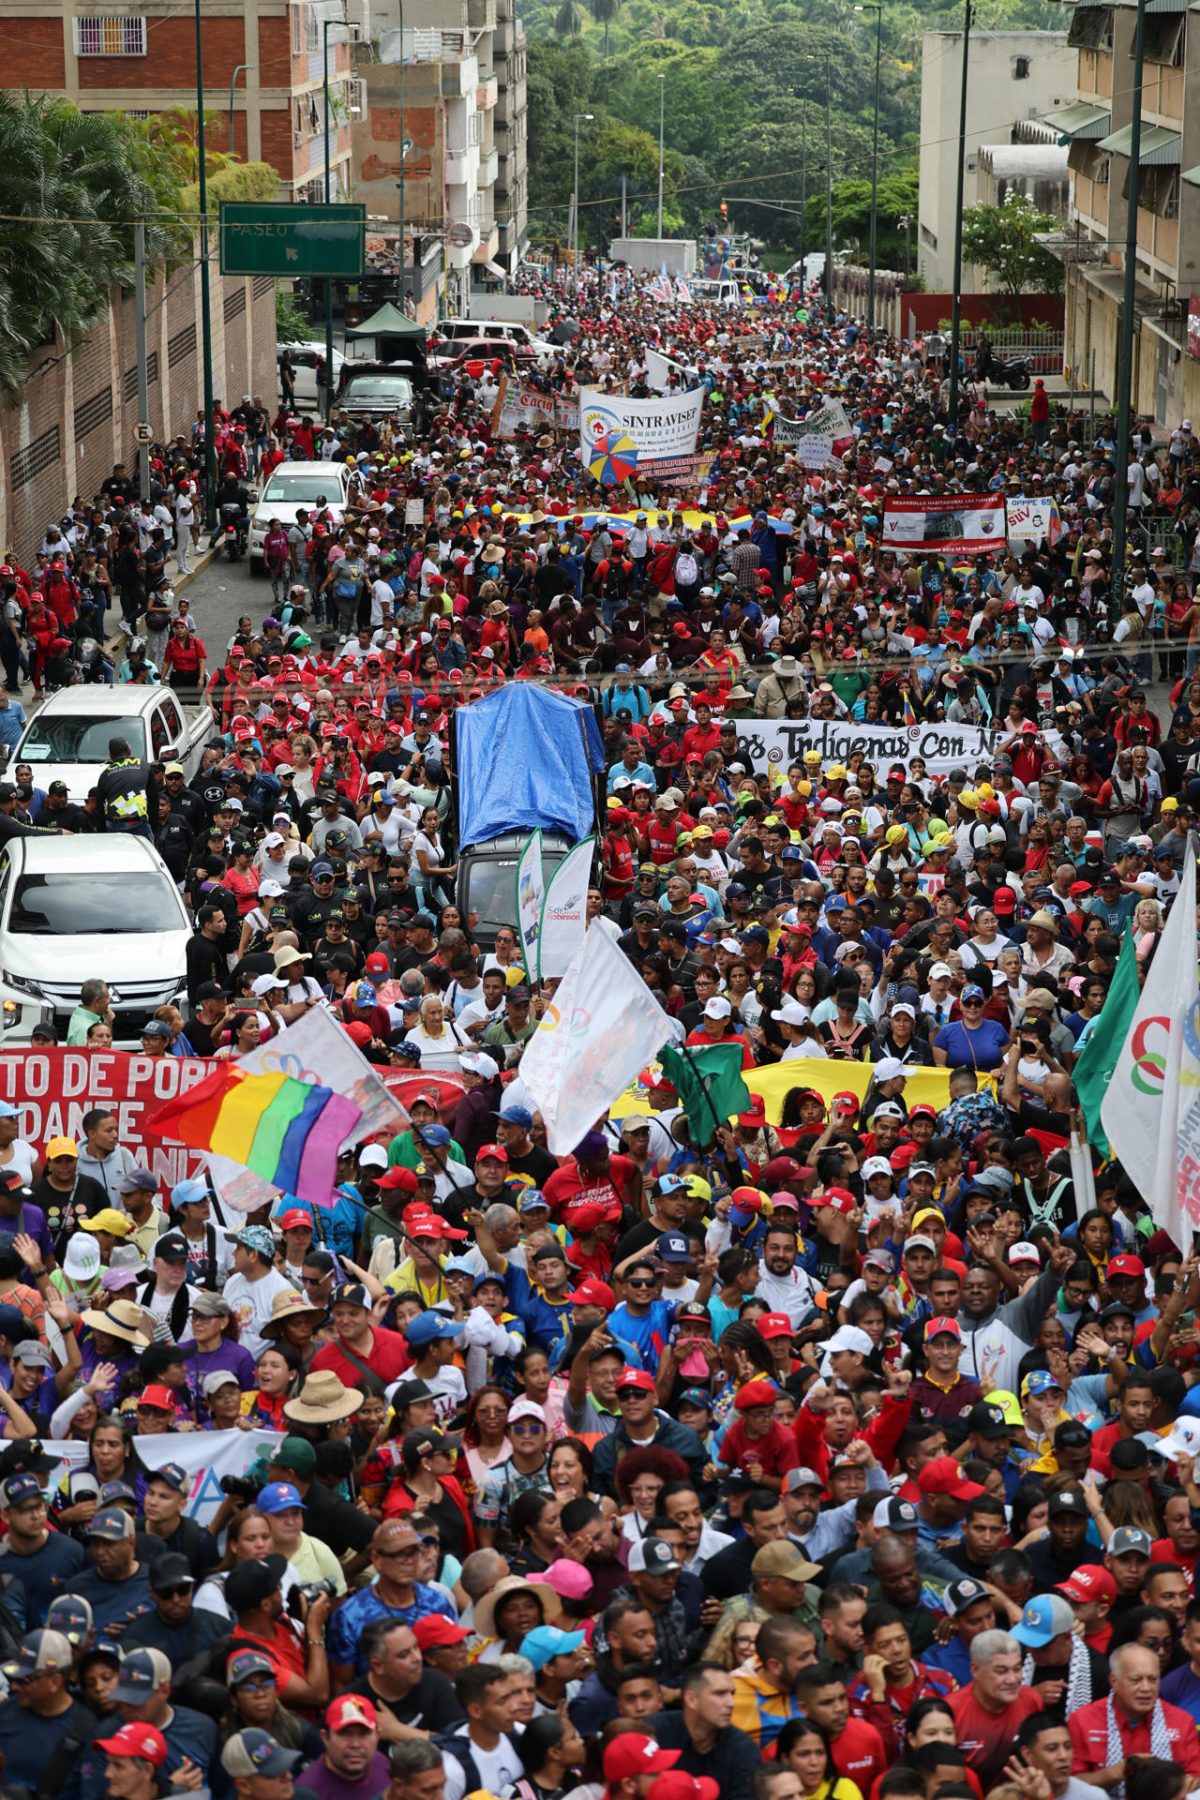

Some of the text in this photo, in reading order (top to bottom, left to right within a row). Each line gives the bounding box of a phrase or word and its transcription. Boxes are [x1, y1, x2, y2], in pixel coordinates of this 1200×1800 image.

[231, 223, 288, 237] PASEO
[622, 407, 698, 429] SINTRAVISEP
[138, 426, 148, 440] E
[1041, 498, 1052, 506] 69
[919, 731, 967, 759] Con
[63, 1054, 115, 1097] DE
